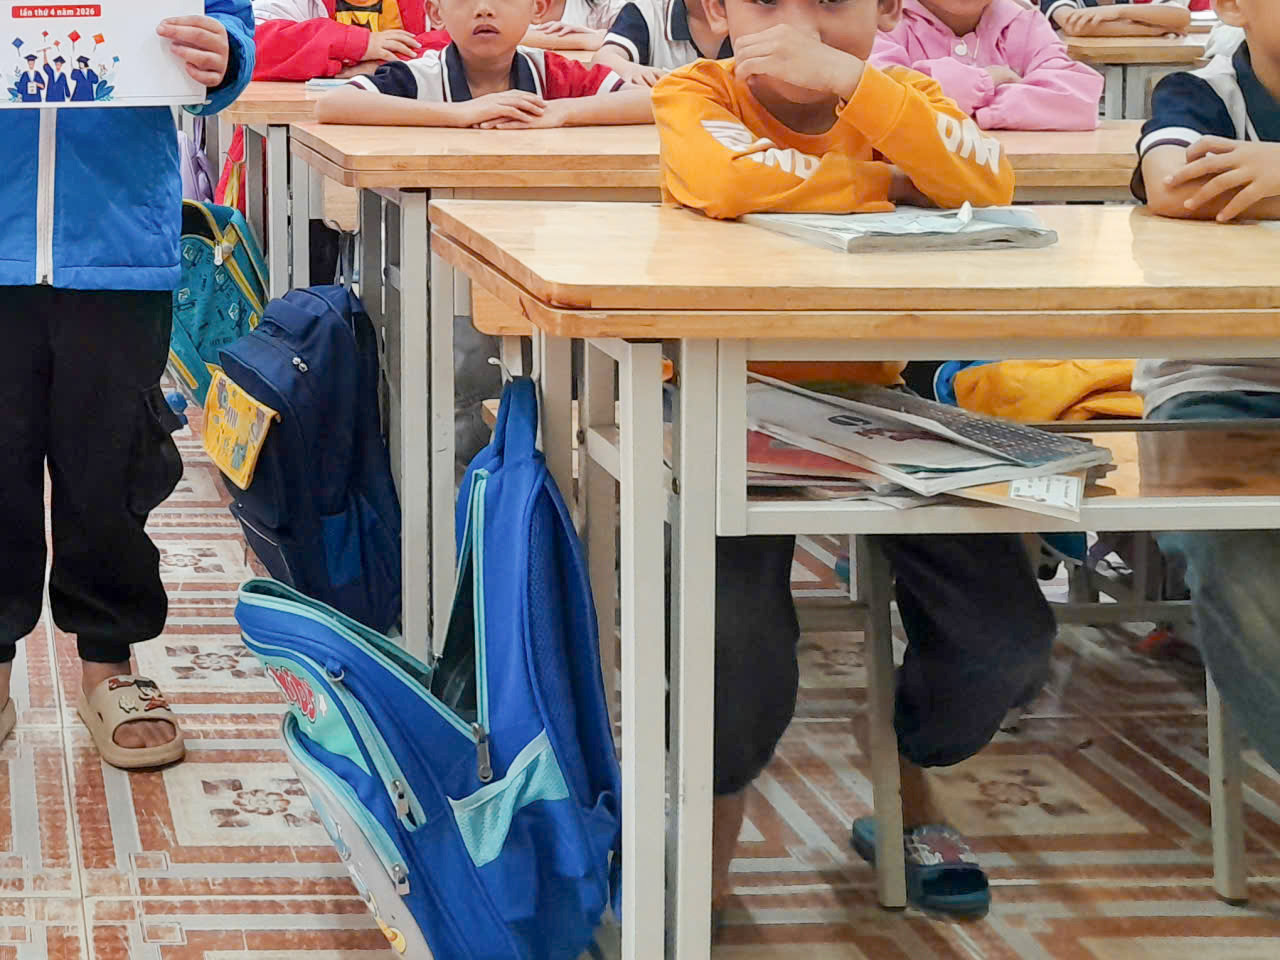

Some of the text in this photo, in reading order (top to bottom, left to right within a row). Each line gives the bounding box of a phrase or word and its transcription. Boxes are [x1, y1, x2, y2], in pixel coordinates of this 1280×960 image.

[50, 8, 55, 16] 4
[56, 7, 74, 16] năm
[76, 7, 95, 16] 2026
